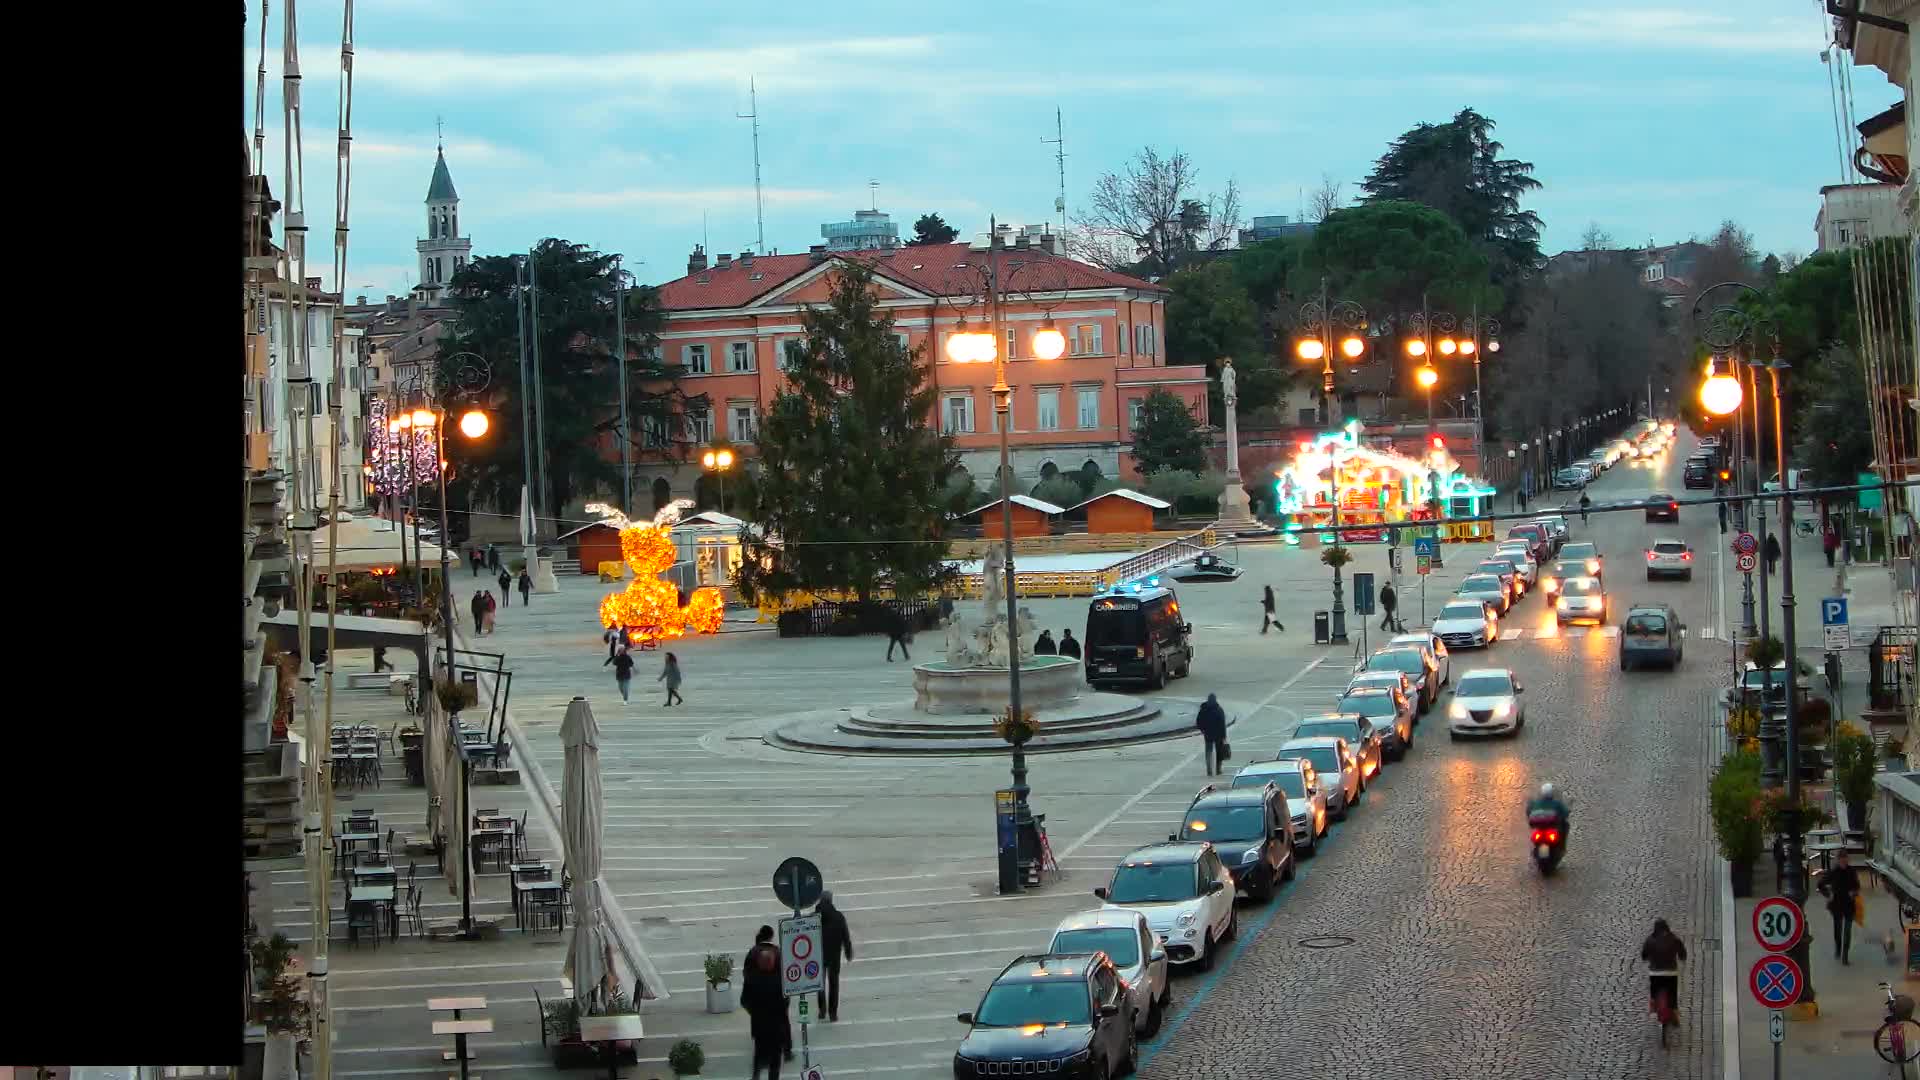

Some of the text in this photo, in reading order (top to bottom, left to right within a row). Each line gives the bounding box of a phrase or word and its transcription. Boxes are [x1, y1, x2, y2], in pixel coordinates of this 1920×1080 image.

[1742, 557, 1753, 567] 20
[1827, 602, 1842, 622] P
[1762, 911, 1792, 938] 30
